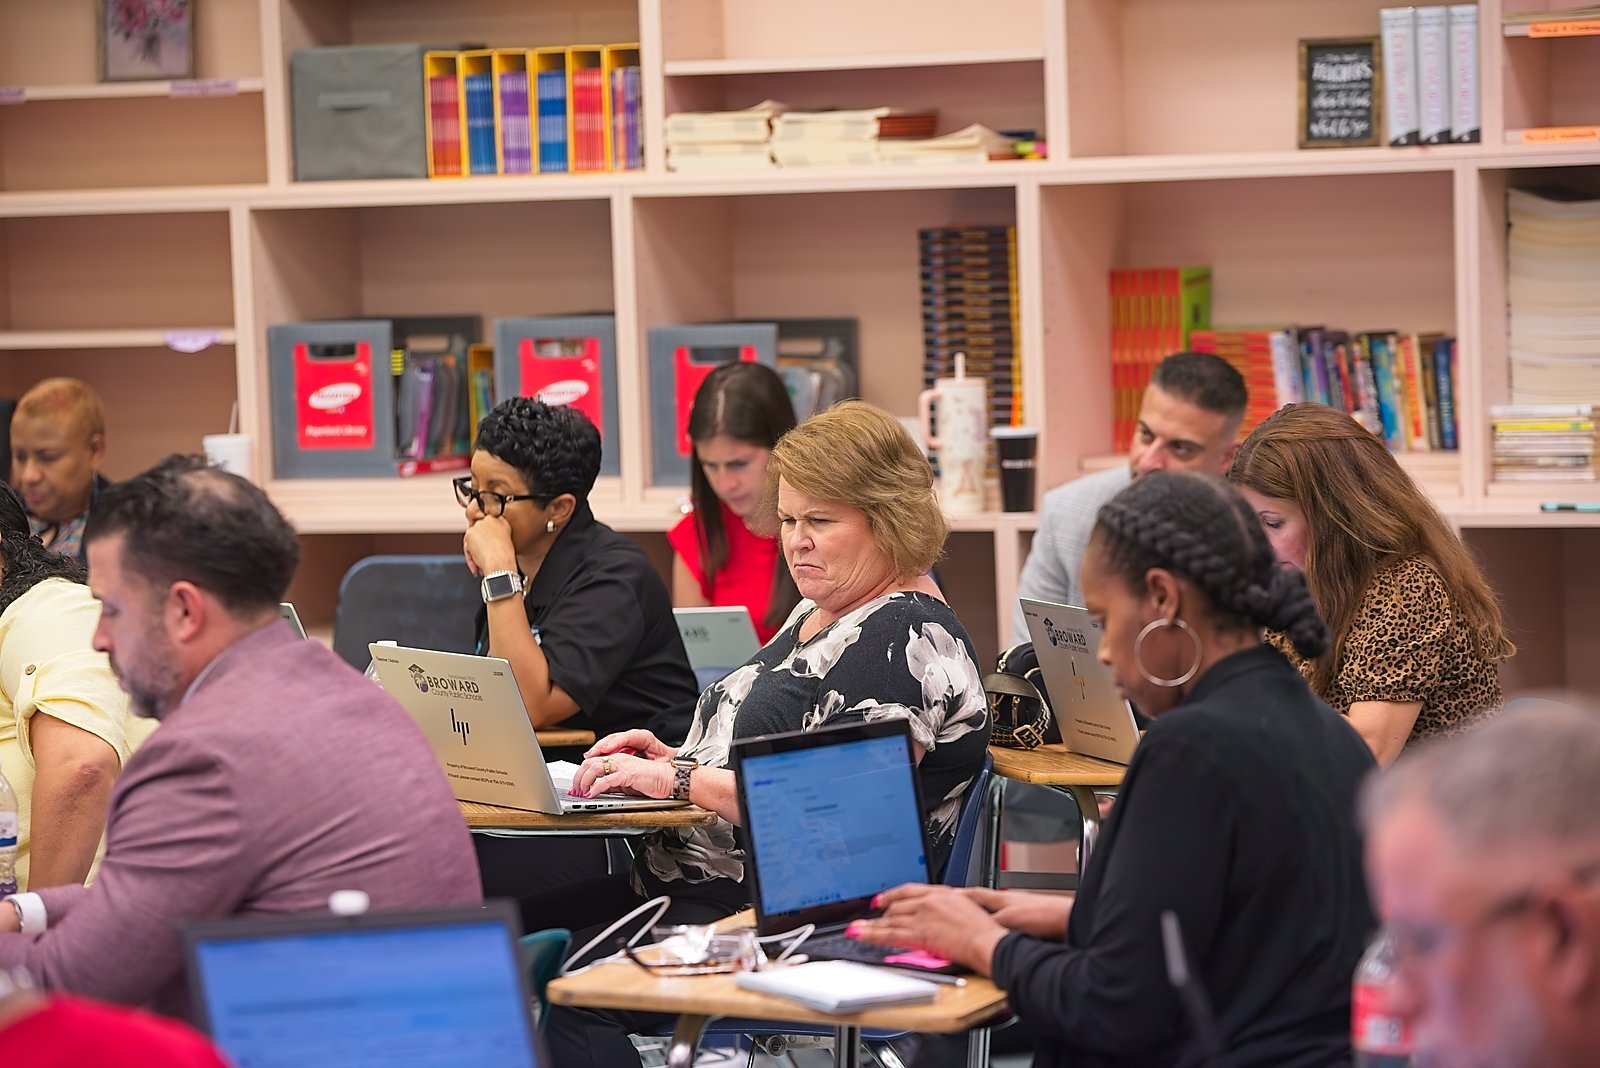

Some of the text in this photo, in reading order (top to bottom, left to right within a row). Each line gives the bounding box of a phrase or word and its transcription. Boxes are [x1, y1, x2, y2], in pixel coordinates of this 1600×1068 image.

[1054, 630, 1087, 646] BROWARD
[426, 676, 480, 694] BROWARD
[432, 688, 483, 702] County Public Schools
